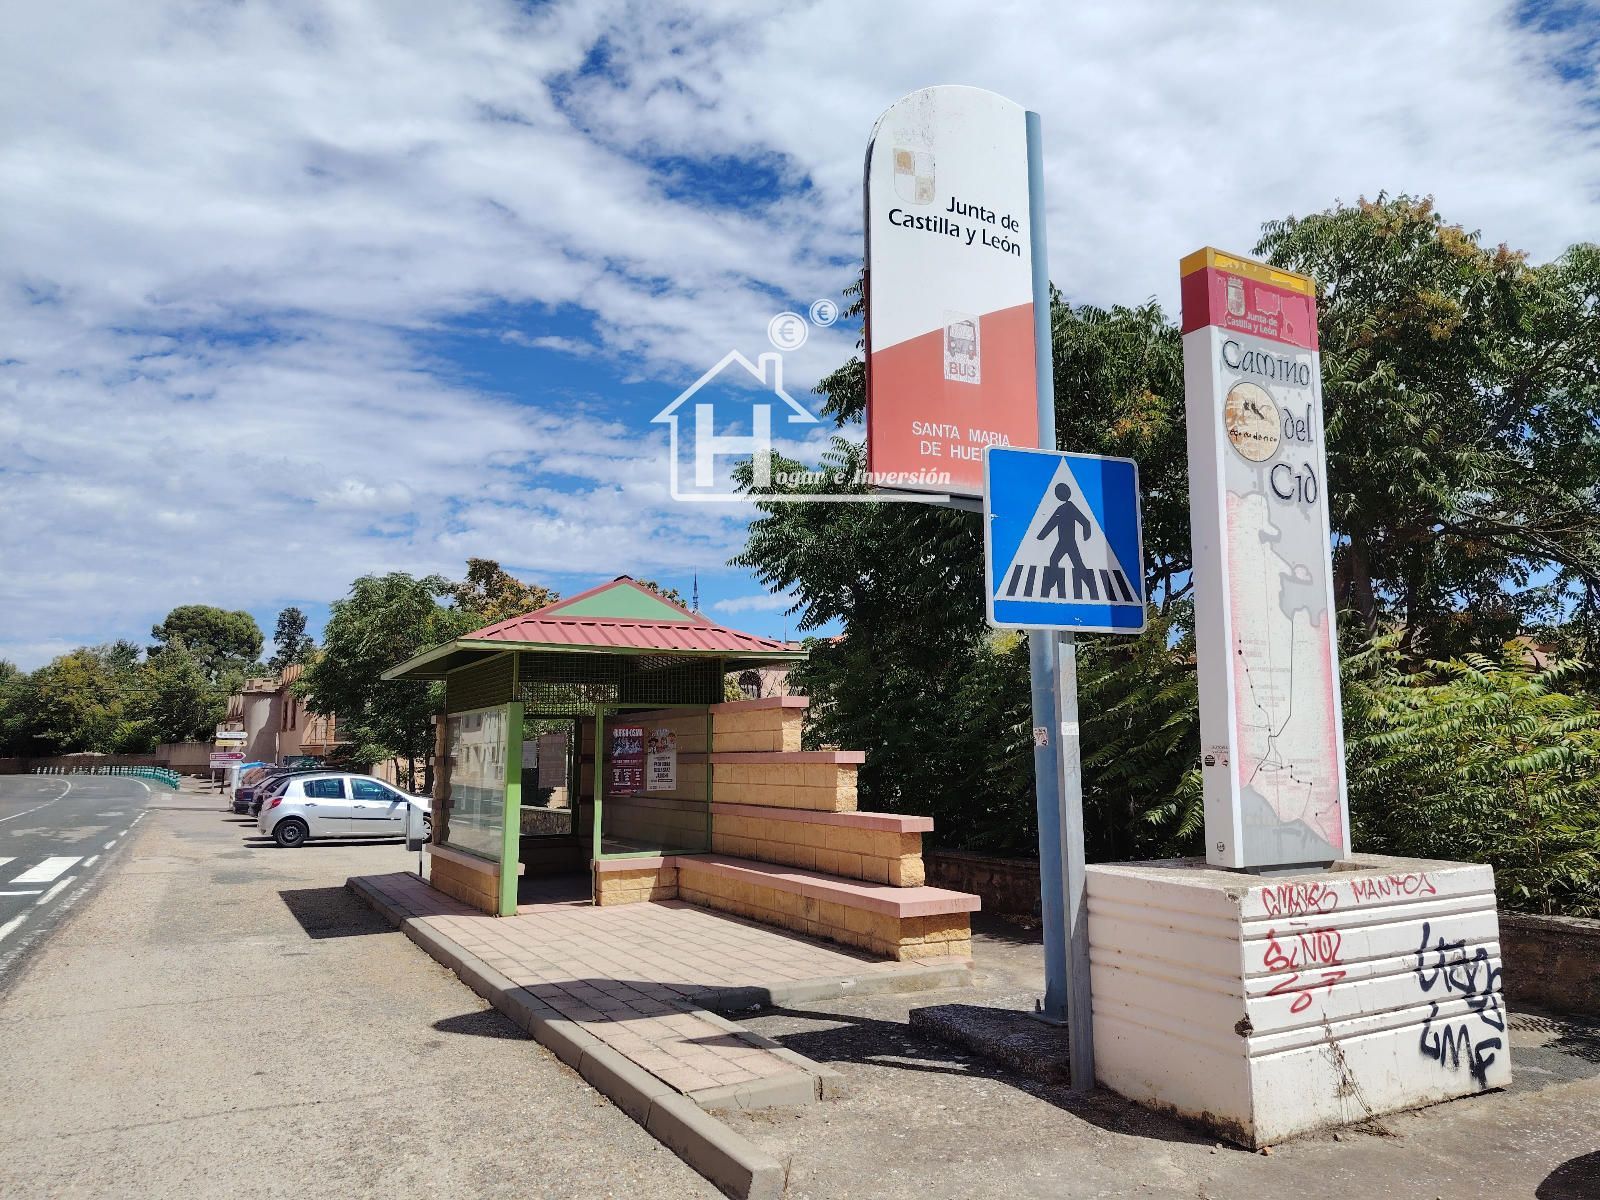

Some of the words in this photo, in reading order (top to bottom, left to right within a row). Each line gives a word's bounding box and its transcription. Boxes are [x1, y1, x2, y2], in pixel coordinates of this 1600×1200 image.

[946, 196, 995, 224] Junta
[1001, 214, 1019, 233] de
[888, 208, 960, 237] Castilla
[965, 227, 976, 246] y
[982, 228, 1021, 257] León
[1227, 316, 1252, 330] Castilla
[1246, 311, 1267, 324] Junta
[949, 361, 977, 378] BUS
[1222, 340, 1310, 386] Camino
[912, 420, 960, 440] SANTA
[968, 428, 1010, 447] MARIA
[1283, 403, 1314, 442] del
[920, 440, 942, 456] DE
[950, 443, 984, 462] HUE
[1270, 462, 1318, 504] Cid
